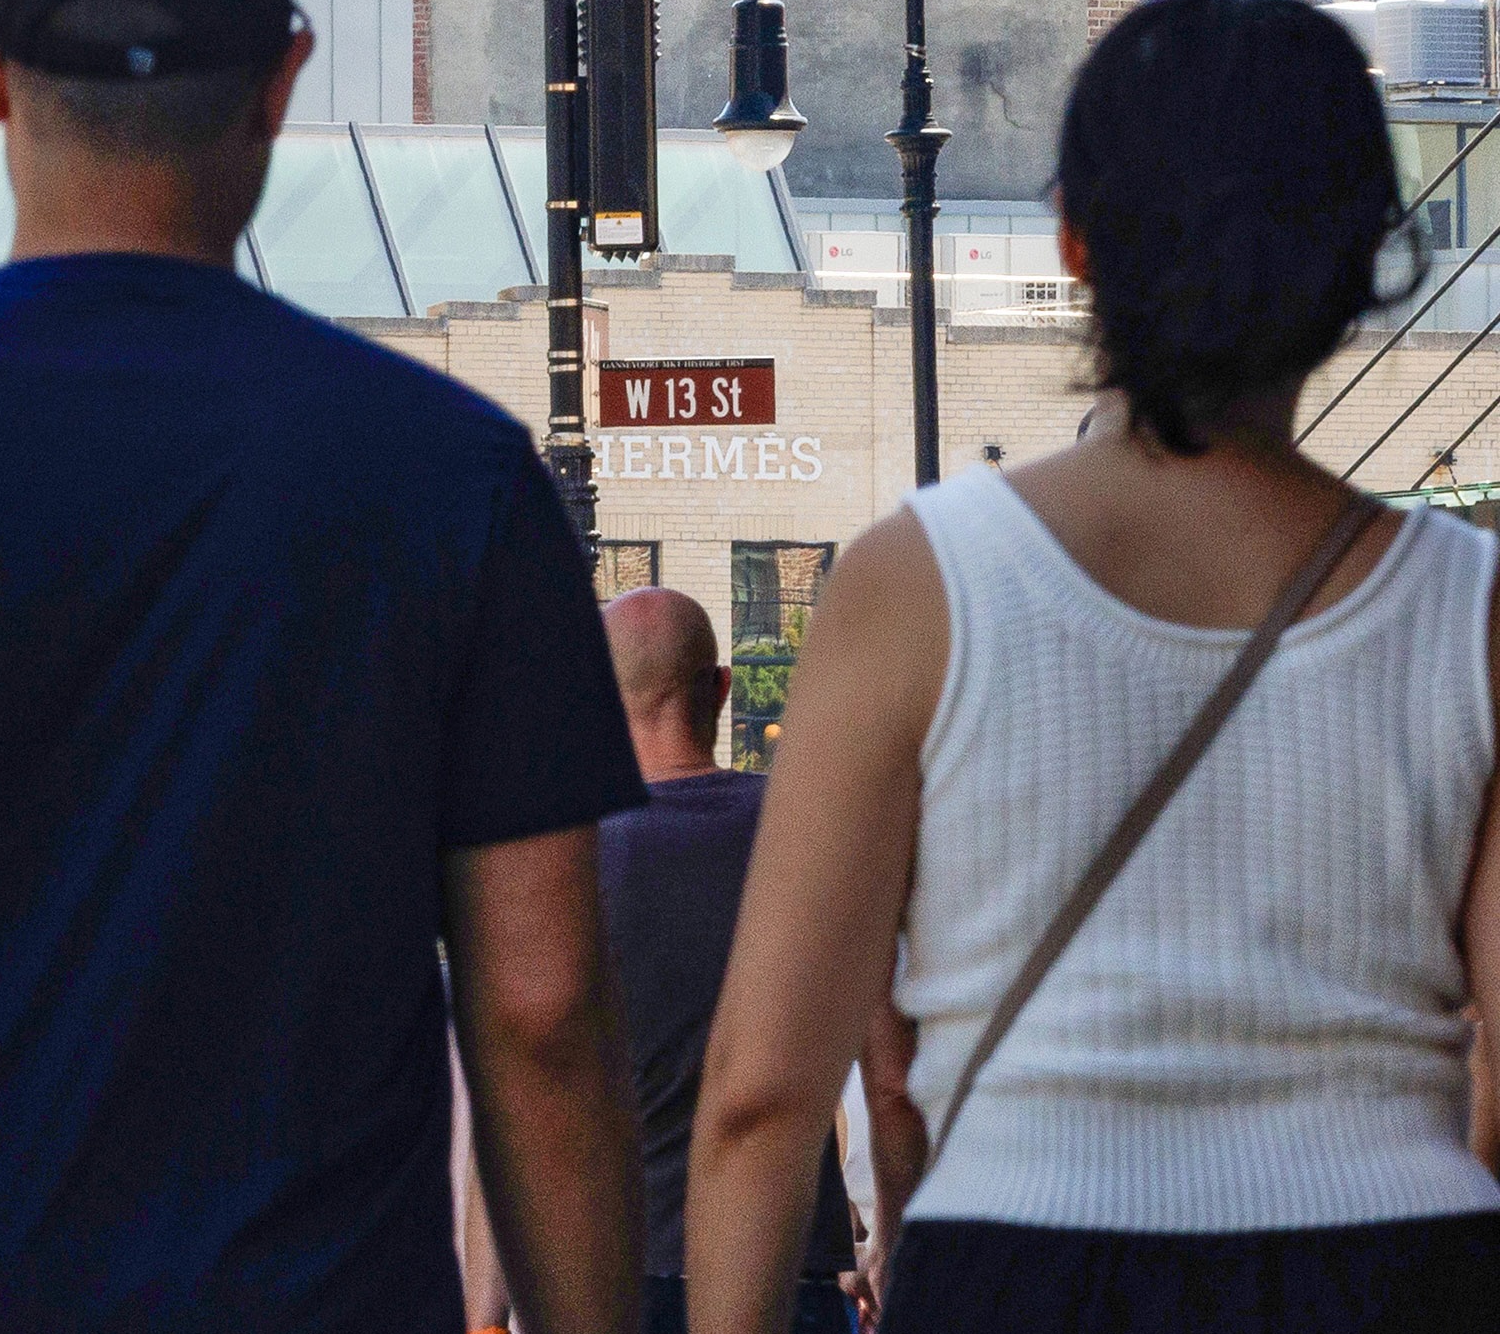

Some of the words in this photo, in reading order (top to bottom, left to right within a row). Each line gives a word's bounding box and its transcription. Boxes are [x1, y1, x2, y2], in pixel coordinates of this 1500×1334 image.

[625, 378, 651, 419] W
[664, 377, 697, 419] 13
[711, 376, 743, 418] St
